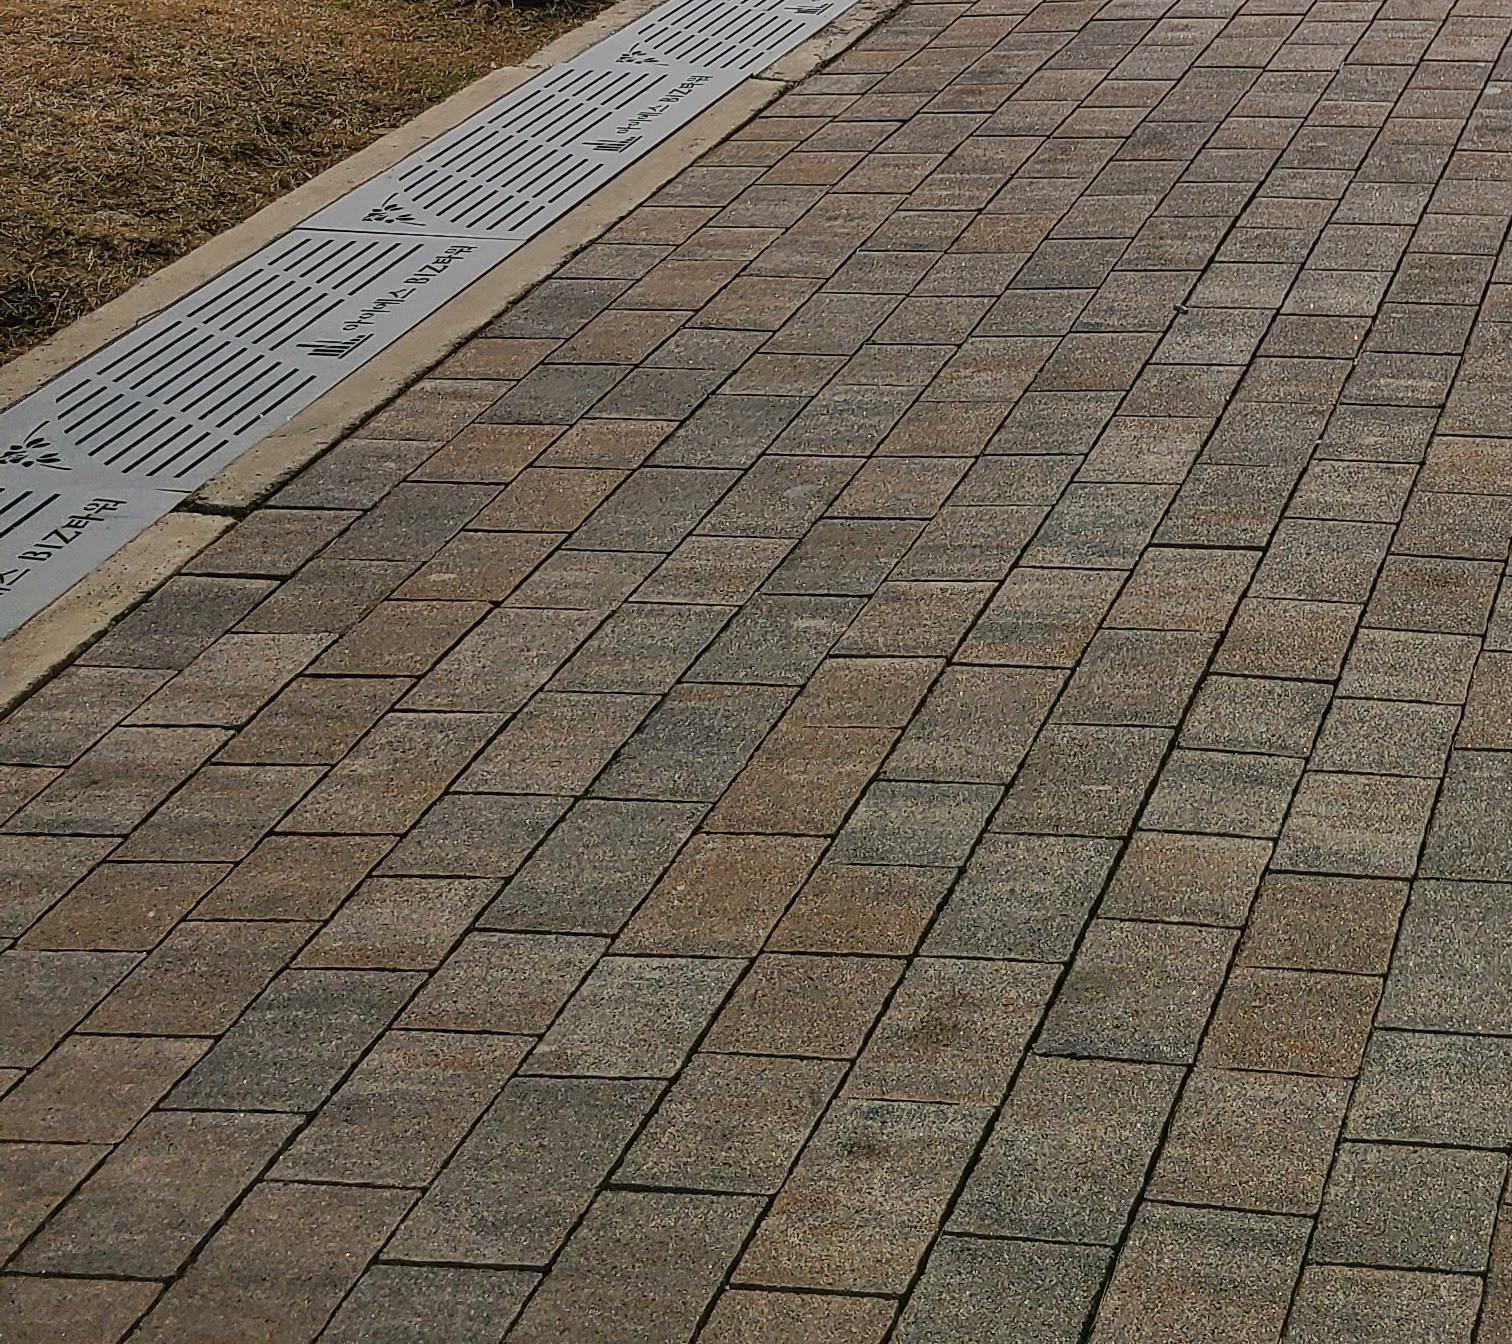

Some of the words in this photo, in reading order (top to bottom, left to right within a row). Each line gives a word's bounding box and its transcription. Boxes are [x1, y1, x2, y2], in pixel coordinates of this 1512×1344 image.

[342, 288, 416, 331] 아이에스
[403, 245, 478, 285] BIZ타워
[17, 498, 127, 562] BIZ타워
